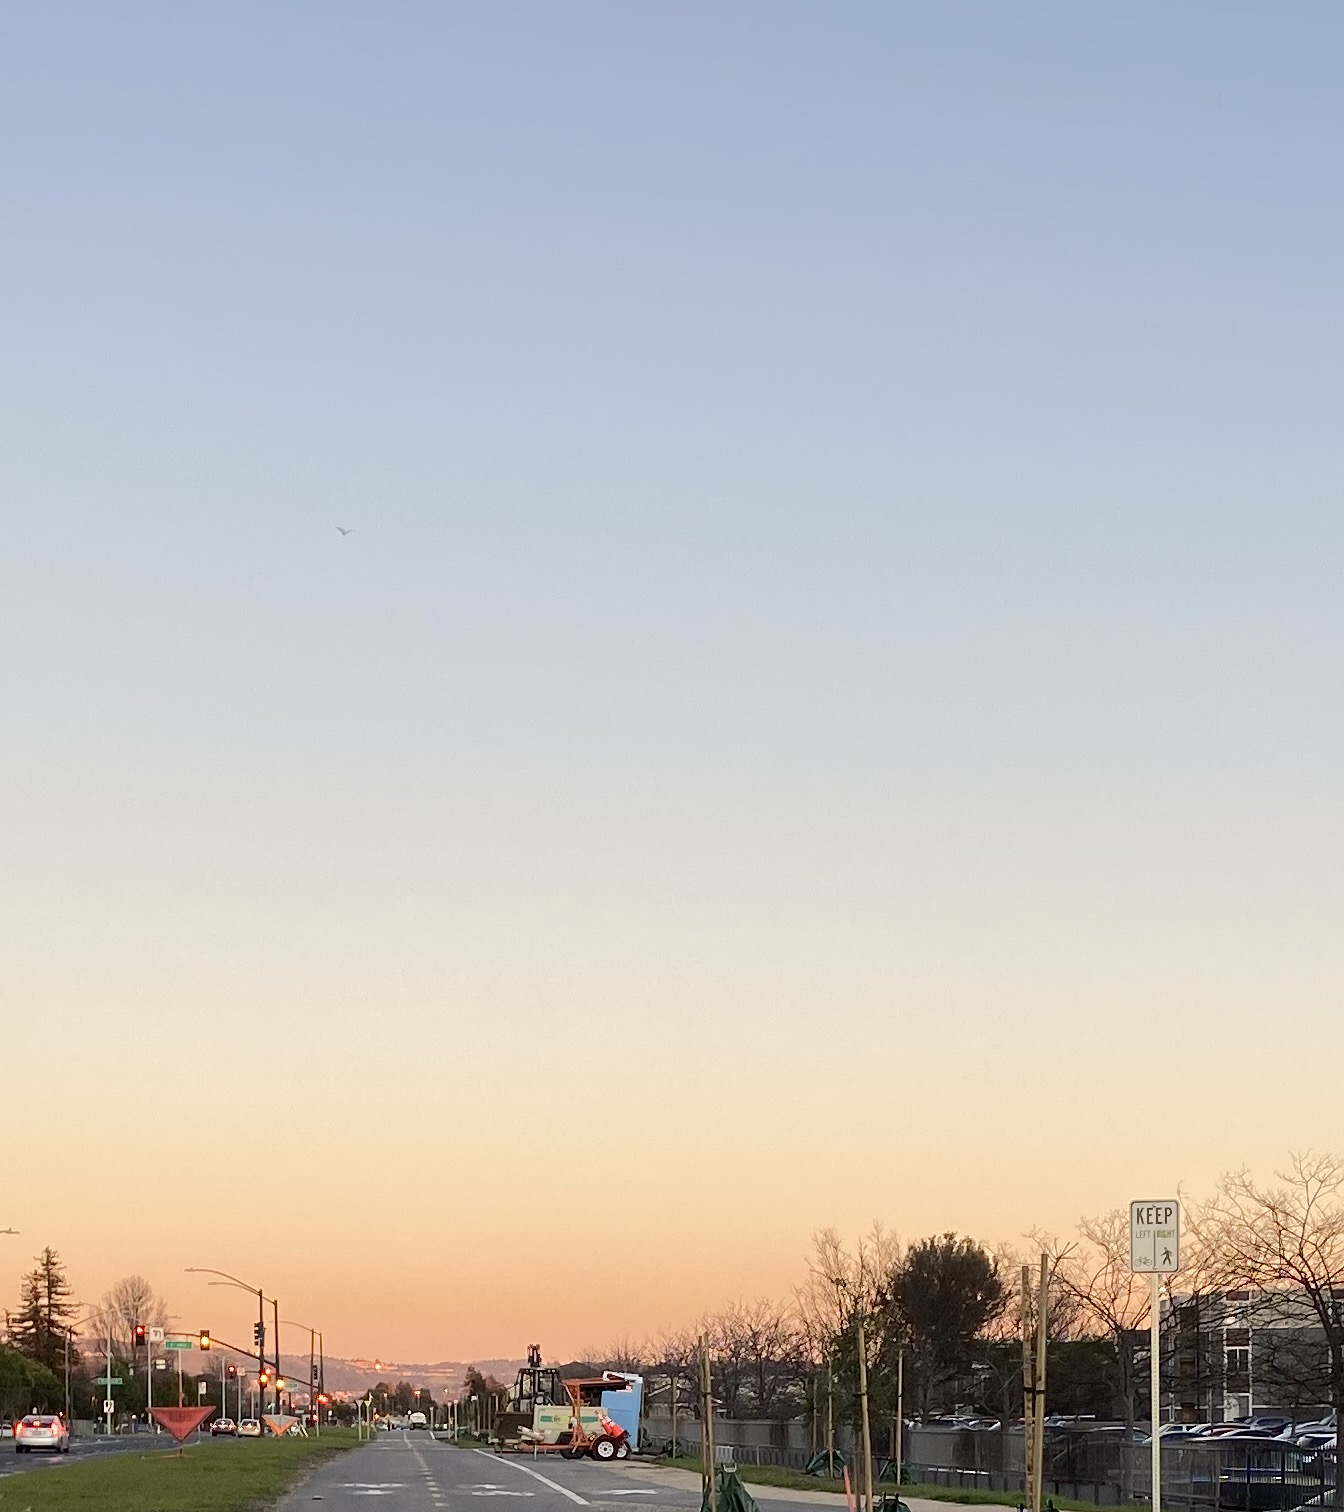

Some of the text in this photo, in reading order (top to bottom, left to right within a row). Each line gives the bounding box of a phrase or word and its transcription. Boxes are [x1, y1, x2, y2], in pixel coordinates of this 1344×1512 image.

[1136, 1207, 1173, 1225] KEEP
[1135, 1230, 1151, 1239] LEFT
[1156, 1229, 1175, 1239] RIGHT
